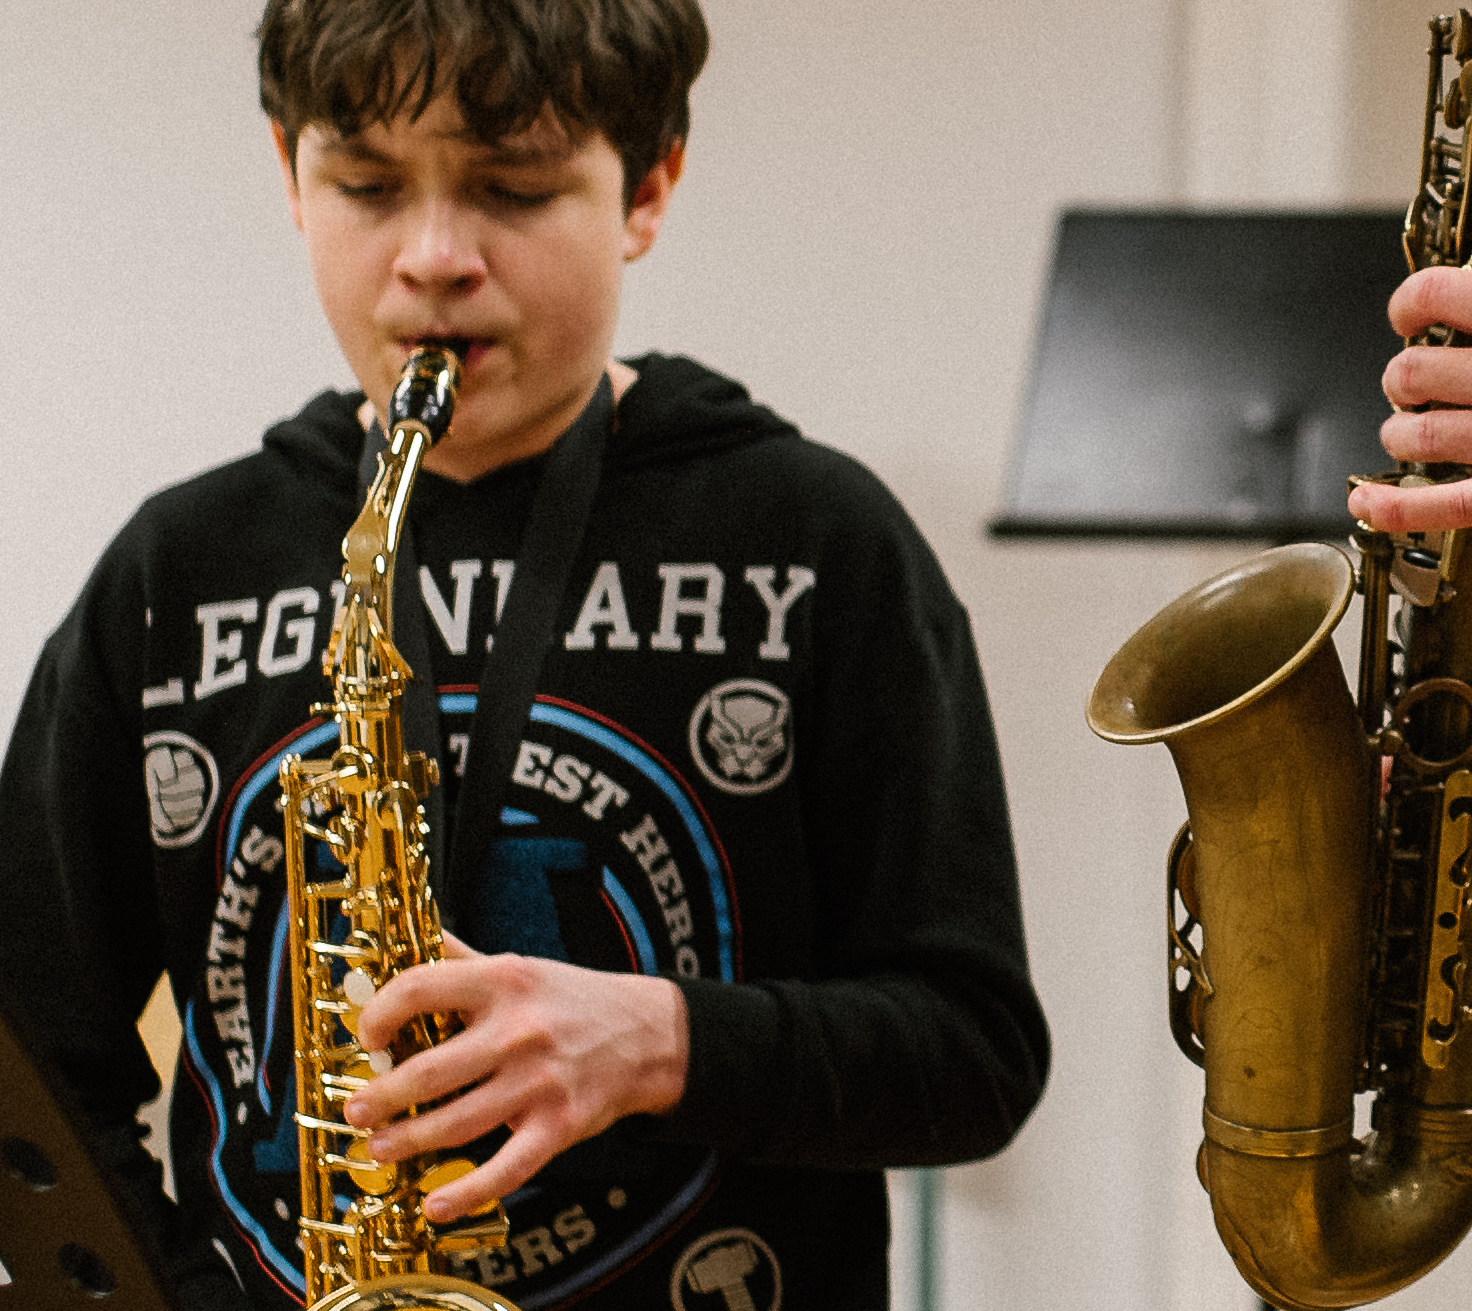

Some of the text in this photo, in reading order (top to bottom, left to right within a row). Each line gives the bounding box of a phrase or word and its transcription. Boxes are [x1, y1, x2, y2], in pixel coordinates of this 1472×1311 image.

[142, 558, 817, 709] EGNARY
[207, 813, 701, 1088] EARTH'S HERO
